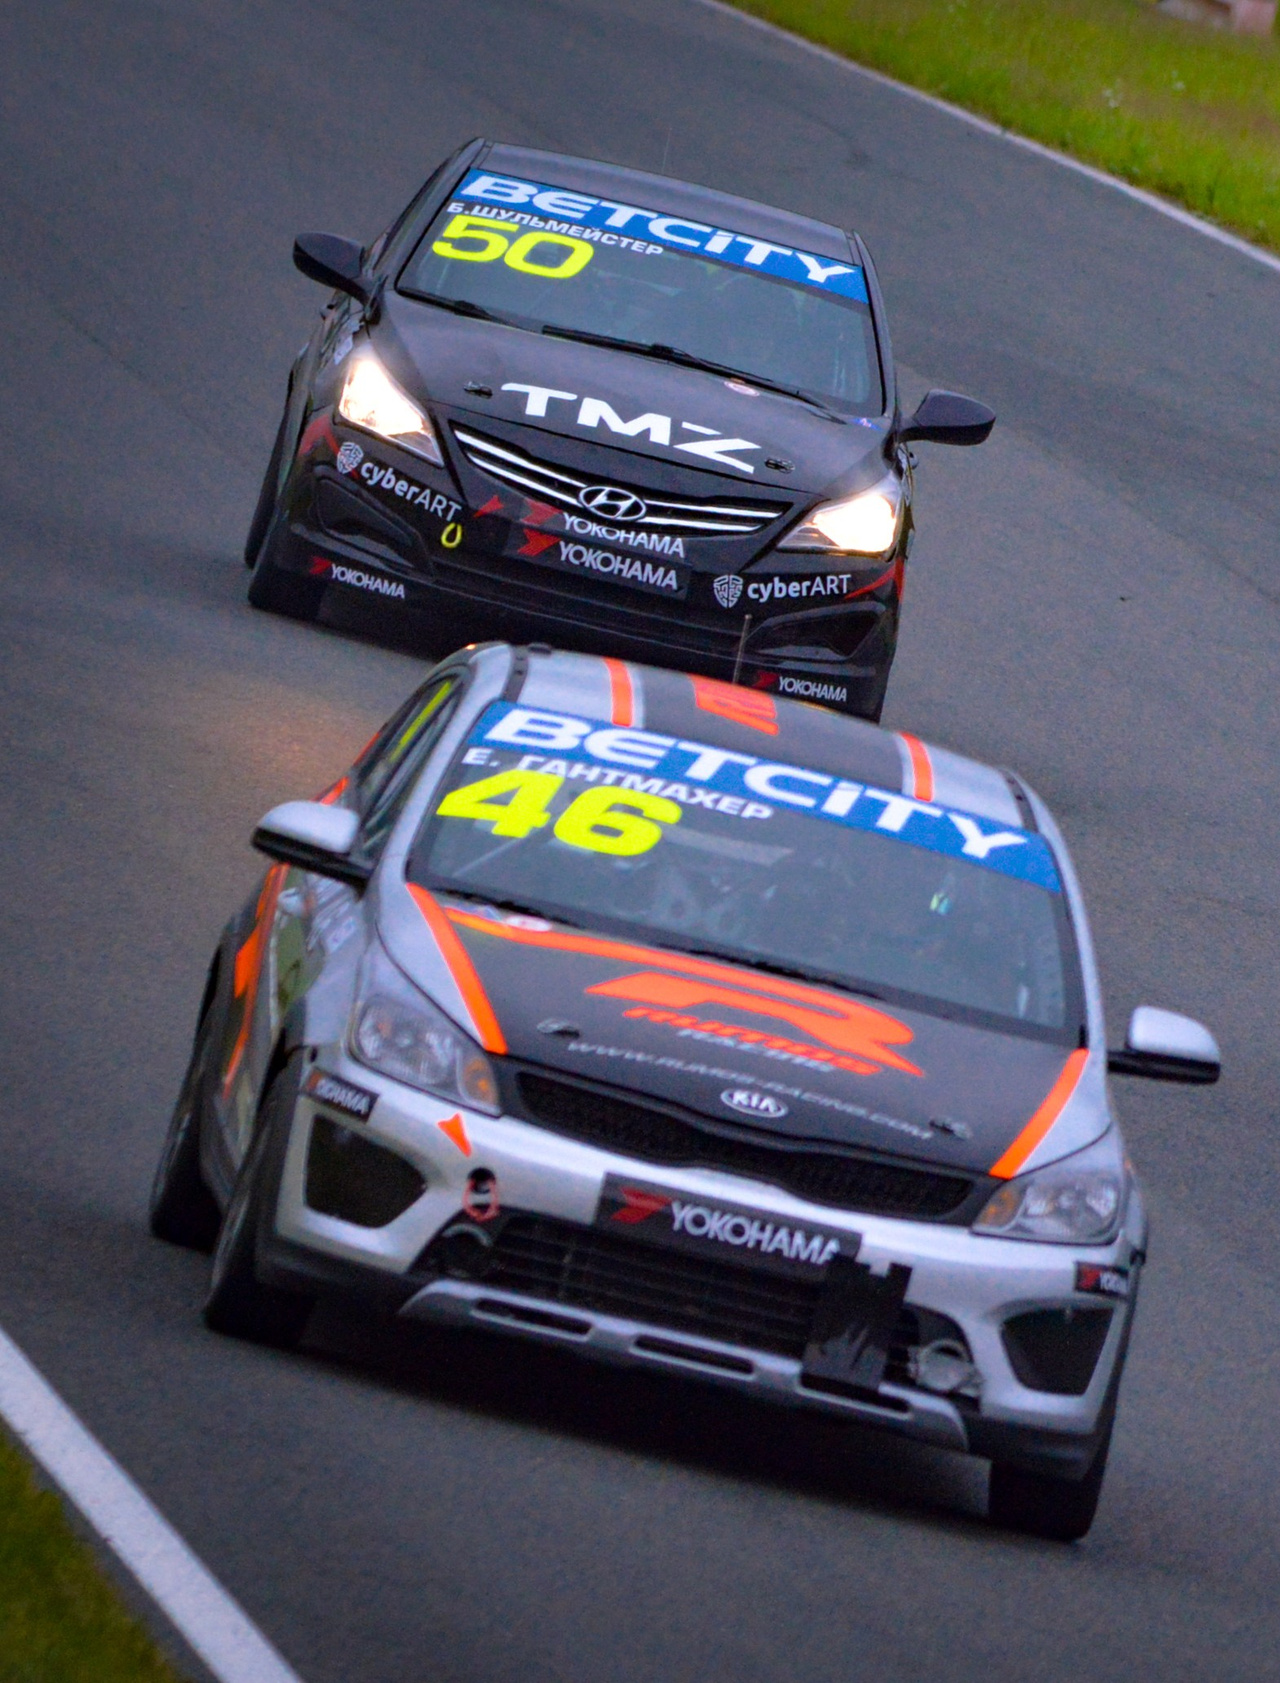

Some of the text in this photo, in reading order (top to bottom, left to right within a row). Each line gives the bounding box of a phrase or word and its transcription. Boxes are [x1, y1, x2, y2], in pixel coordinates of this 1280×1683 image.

[431, 213, 595, 279] 50
[461, 175, 856, 284] BETCITY
[501, 382, 762, 475] TMZ
[360, 461, 463, 522] cyberART
[558, 540, 679, 590] YOKOHAMA
[562, 511, 686, 559] YOKOHAMA
[330, 563, 406, 600] YOKOHAMA
[746, 574, 852, 603] cyberART
[778, 675, 848, 702] YOKOHAMA
[436, 769, 683, 856] 46
[483, 708, 1028, 859] BETCITY
[516, 753, 775, 819] ГАНТМАХЕР
[730, 1088, 780, 1114] KIA
